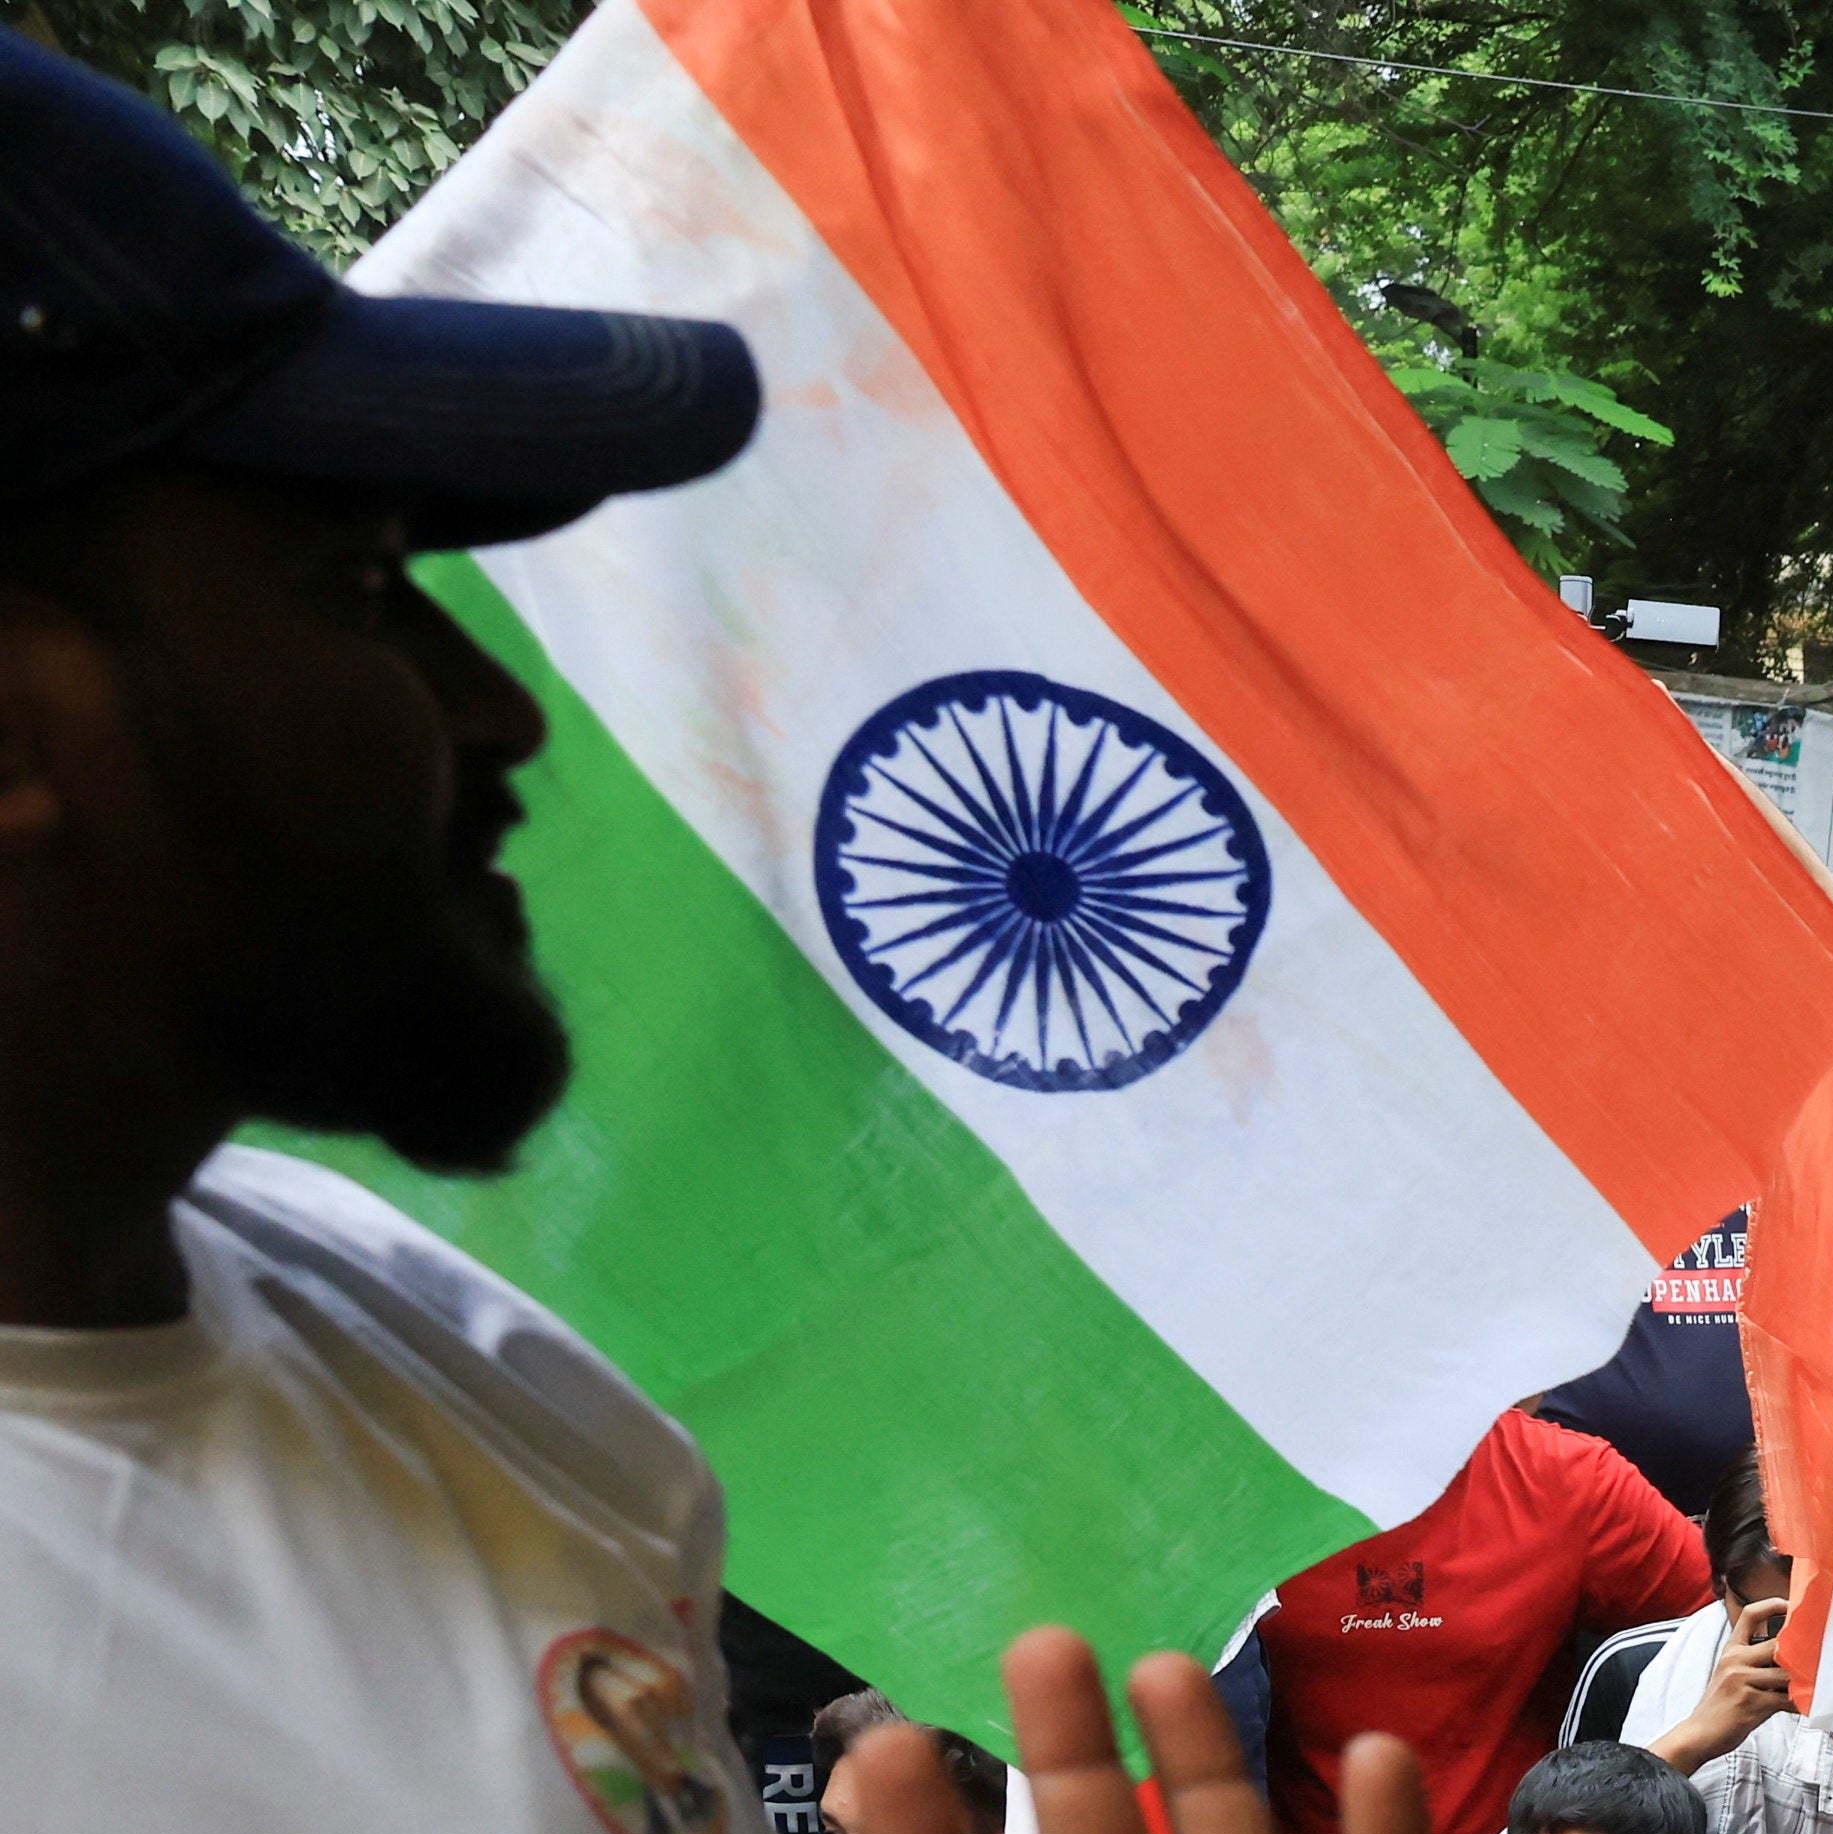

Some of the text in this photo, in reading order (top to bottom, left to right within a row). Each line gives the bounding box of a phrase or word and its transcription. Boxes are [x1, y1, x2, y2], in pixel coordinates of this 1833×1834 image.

[1686, 1314, 1711, 1324] NICE
[1340, 1611, 1443, 1634] Freak Show
